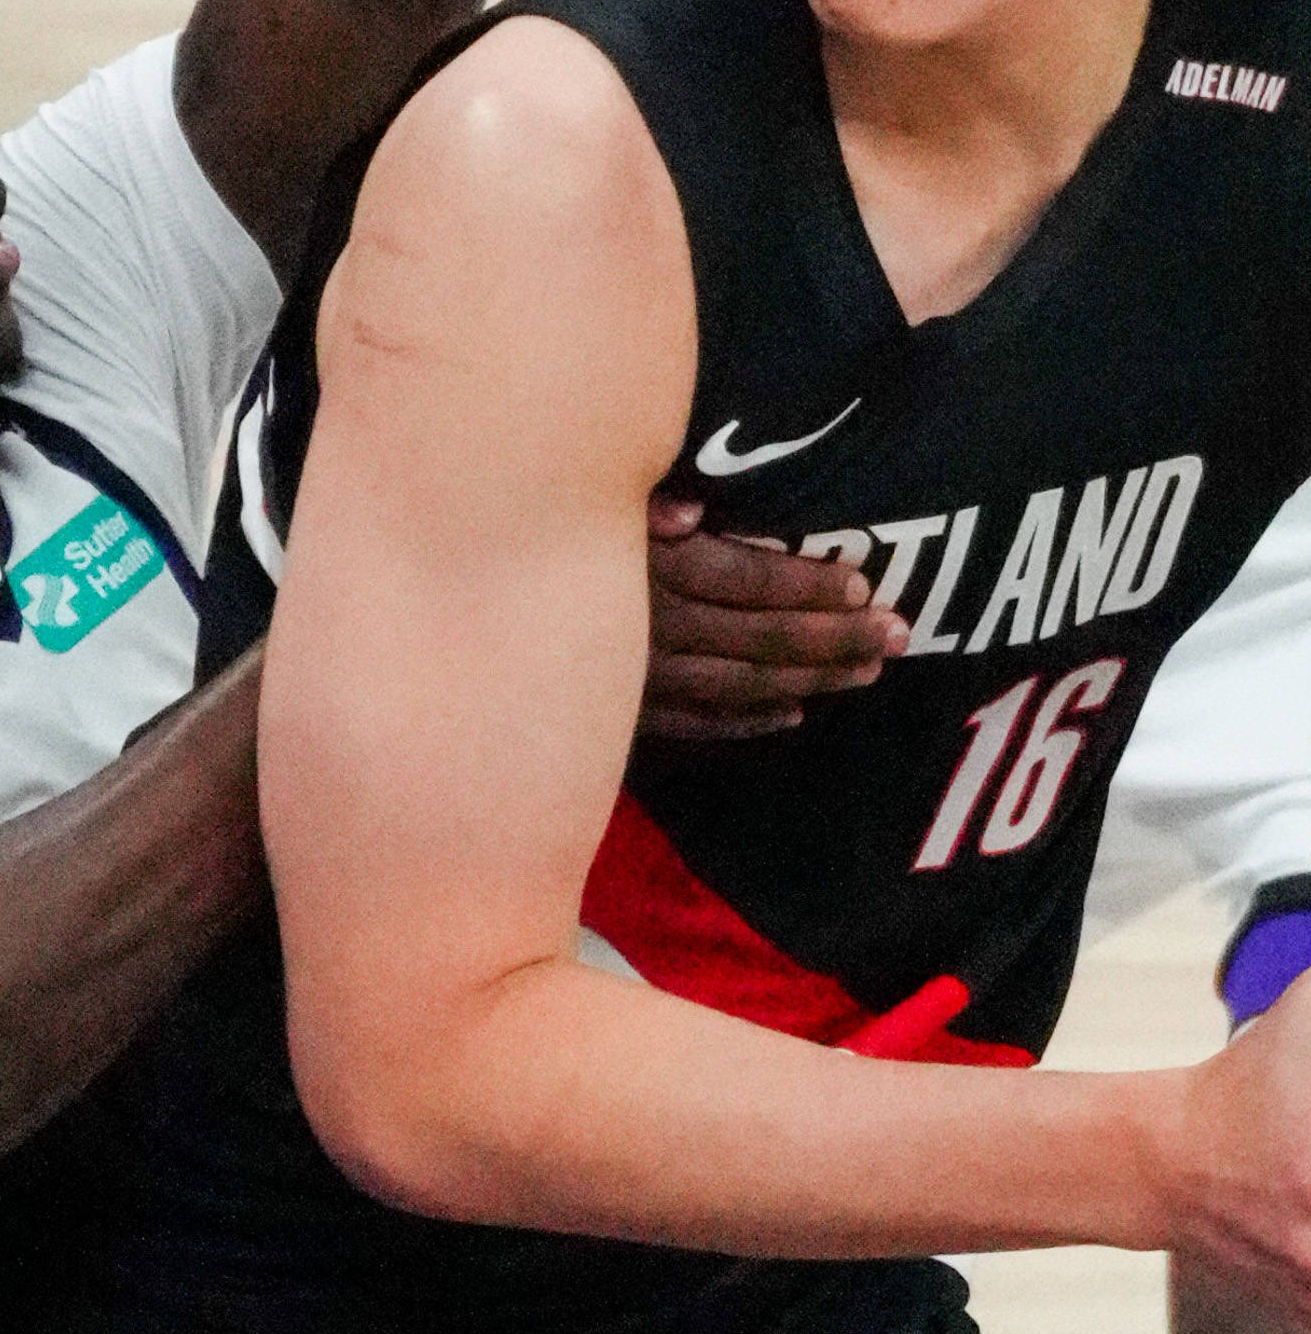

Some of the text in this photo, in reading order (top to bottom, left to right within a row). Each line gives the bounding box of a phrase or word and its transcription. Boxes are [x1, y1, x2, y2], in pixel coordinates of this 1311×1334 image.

[1165, 58, 1286, 113] ADELMAN
[64, 510, 130, 570] Sutter
[86, 537, 155, 599] Health
[911, 659, 1126, 872] 16
